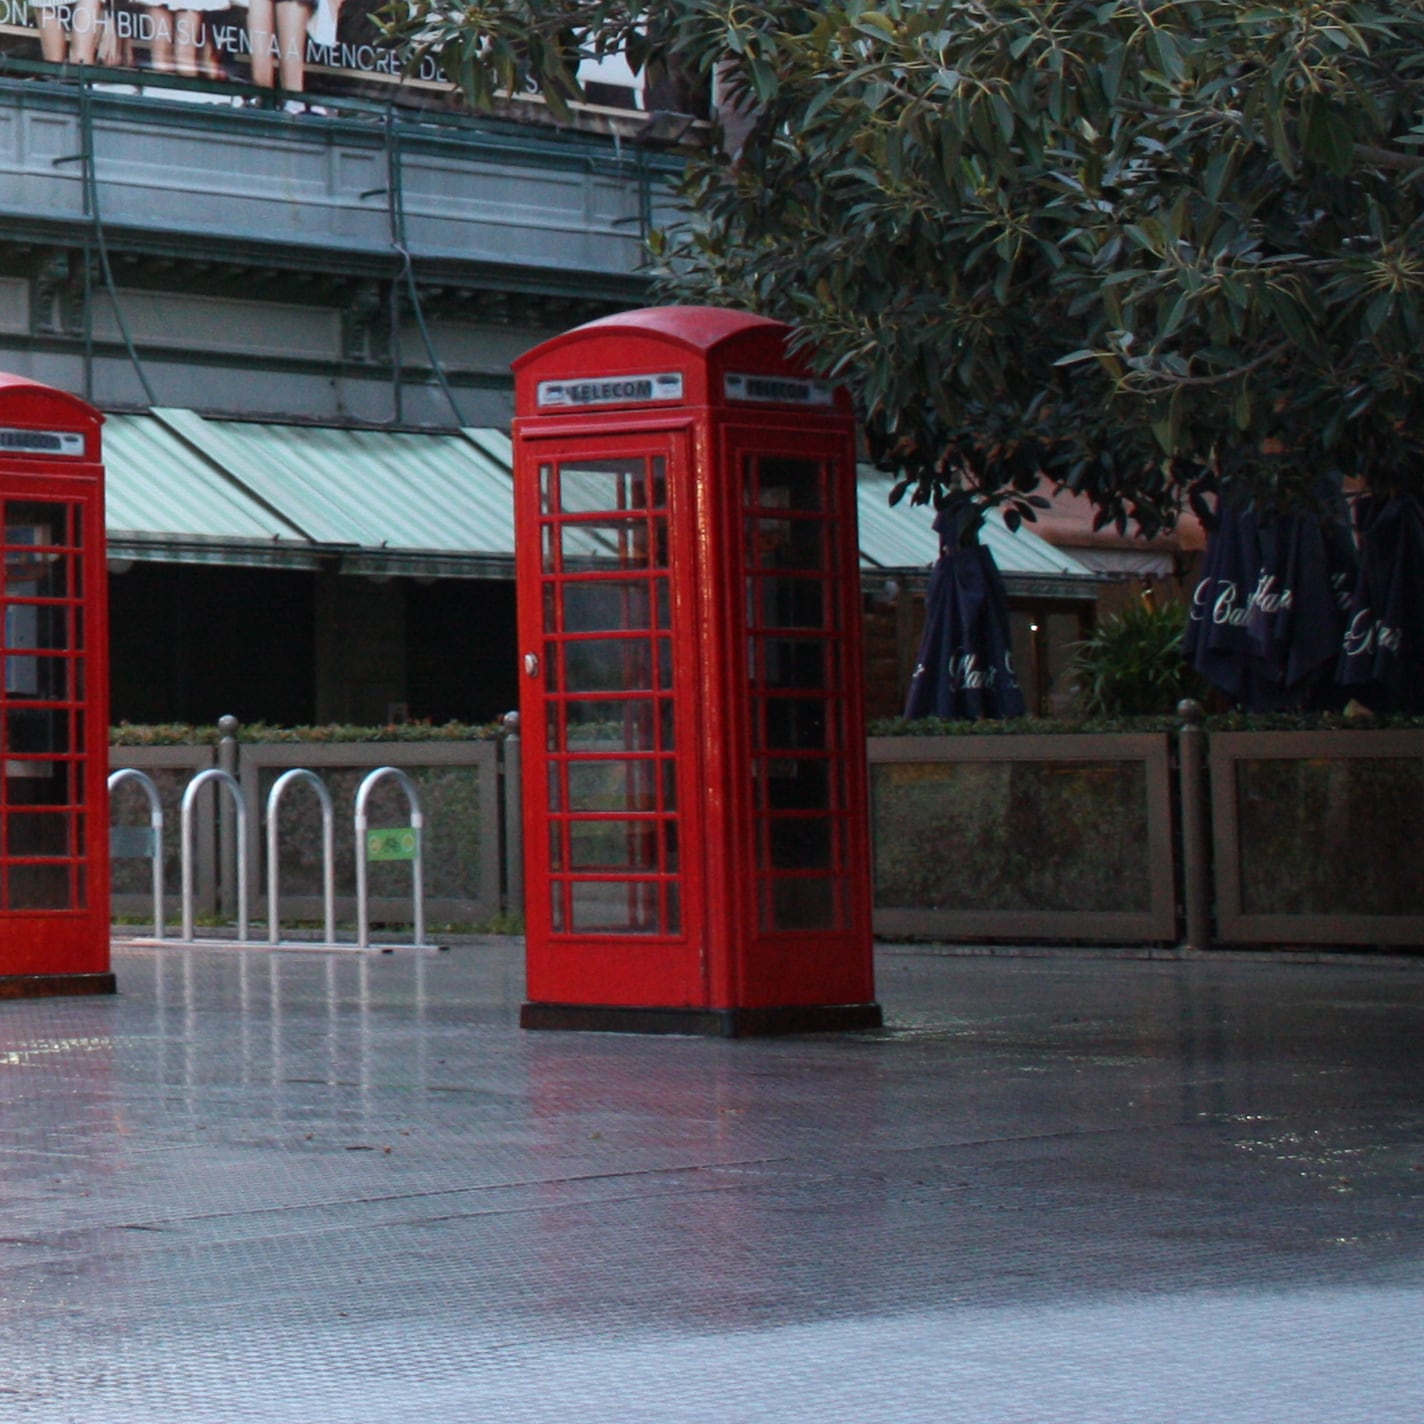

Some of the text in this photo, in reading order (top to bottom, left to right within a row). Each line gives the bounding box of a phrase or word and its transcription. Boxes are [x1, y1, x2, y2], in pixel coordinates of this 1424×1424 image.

[175, 19, 206, 48] SU
[212, 23, 281, 61] VENTA
[286, 40, 300, 62] A
[306, 39, 414, 77] MENORE
[572, 380, 652, 402] TELECOM
